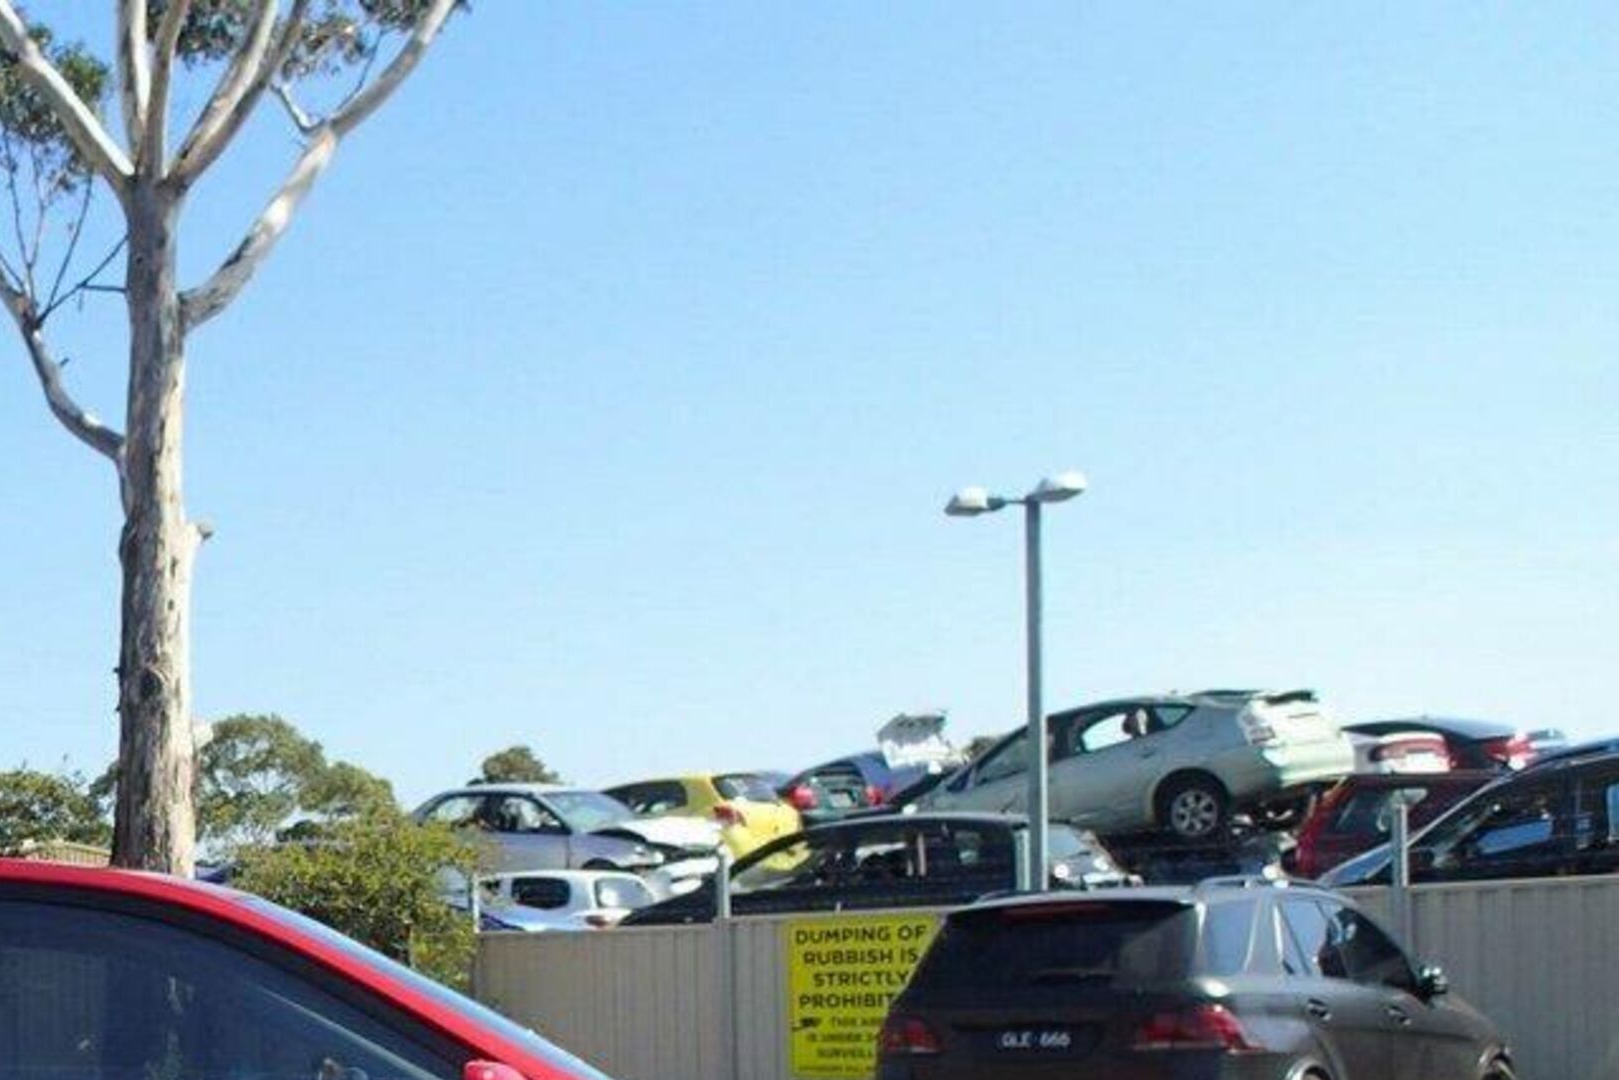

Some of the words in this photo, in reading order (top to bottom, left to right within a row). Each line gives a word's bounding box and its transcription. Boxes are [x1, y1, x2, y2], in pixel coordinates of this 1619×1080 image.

[795, 925, 891, 944] DUMPING
[897, 924, 927, 941] OF
[803, 949, 893, 966] RUBBISH
[900, 949, 918, 964] IS
[813, 970, 909, 987] STRICTLY
